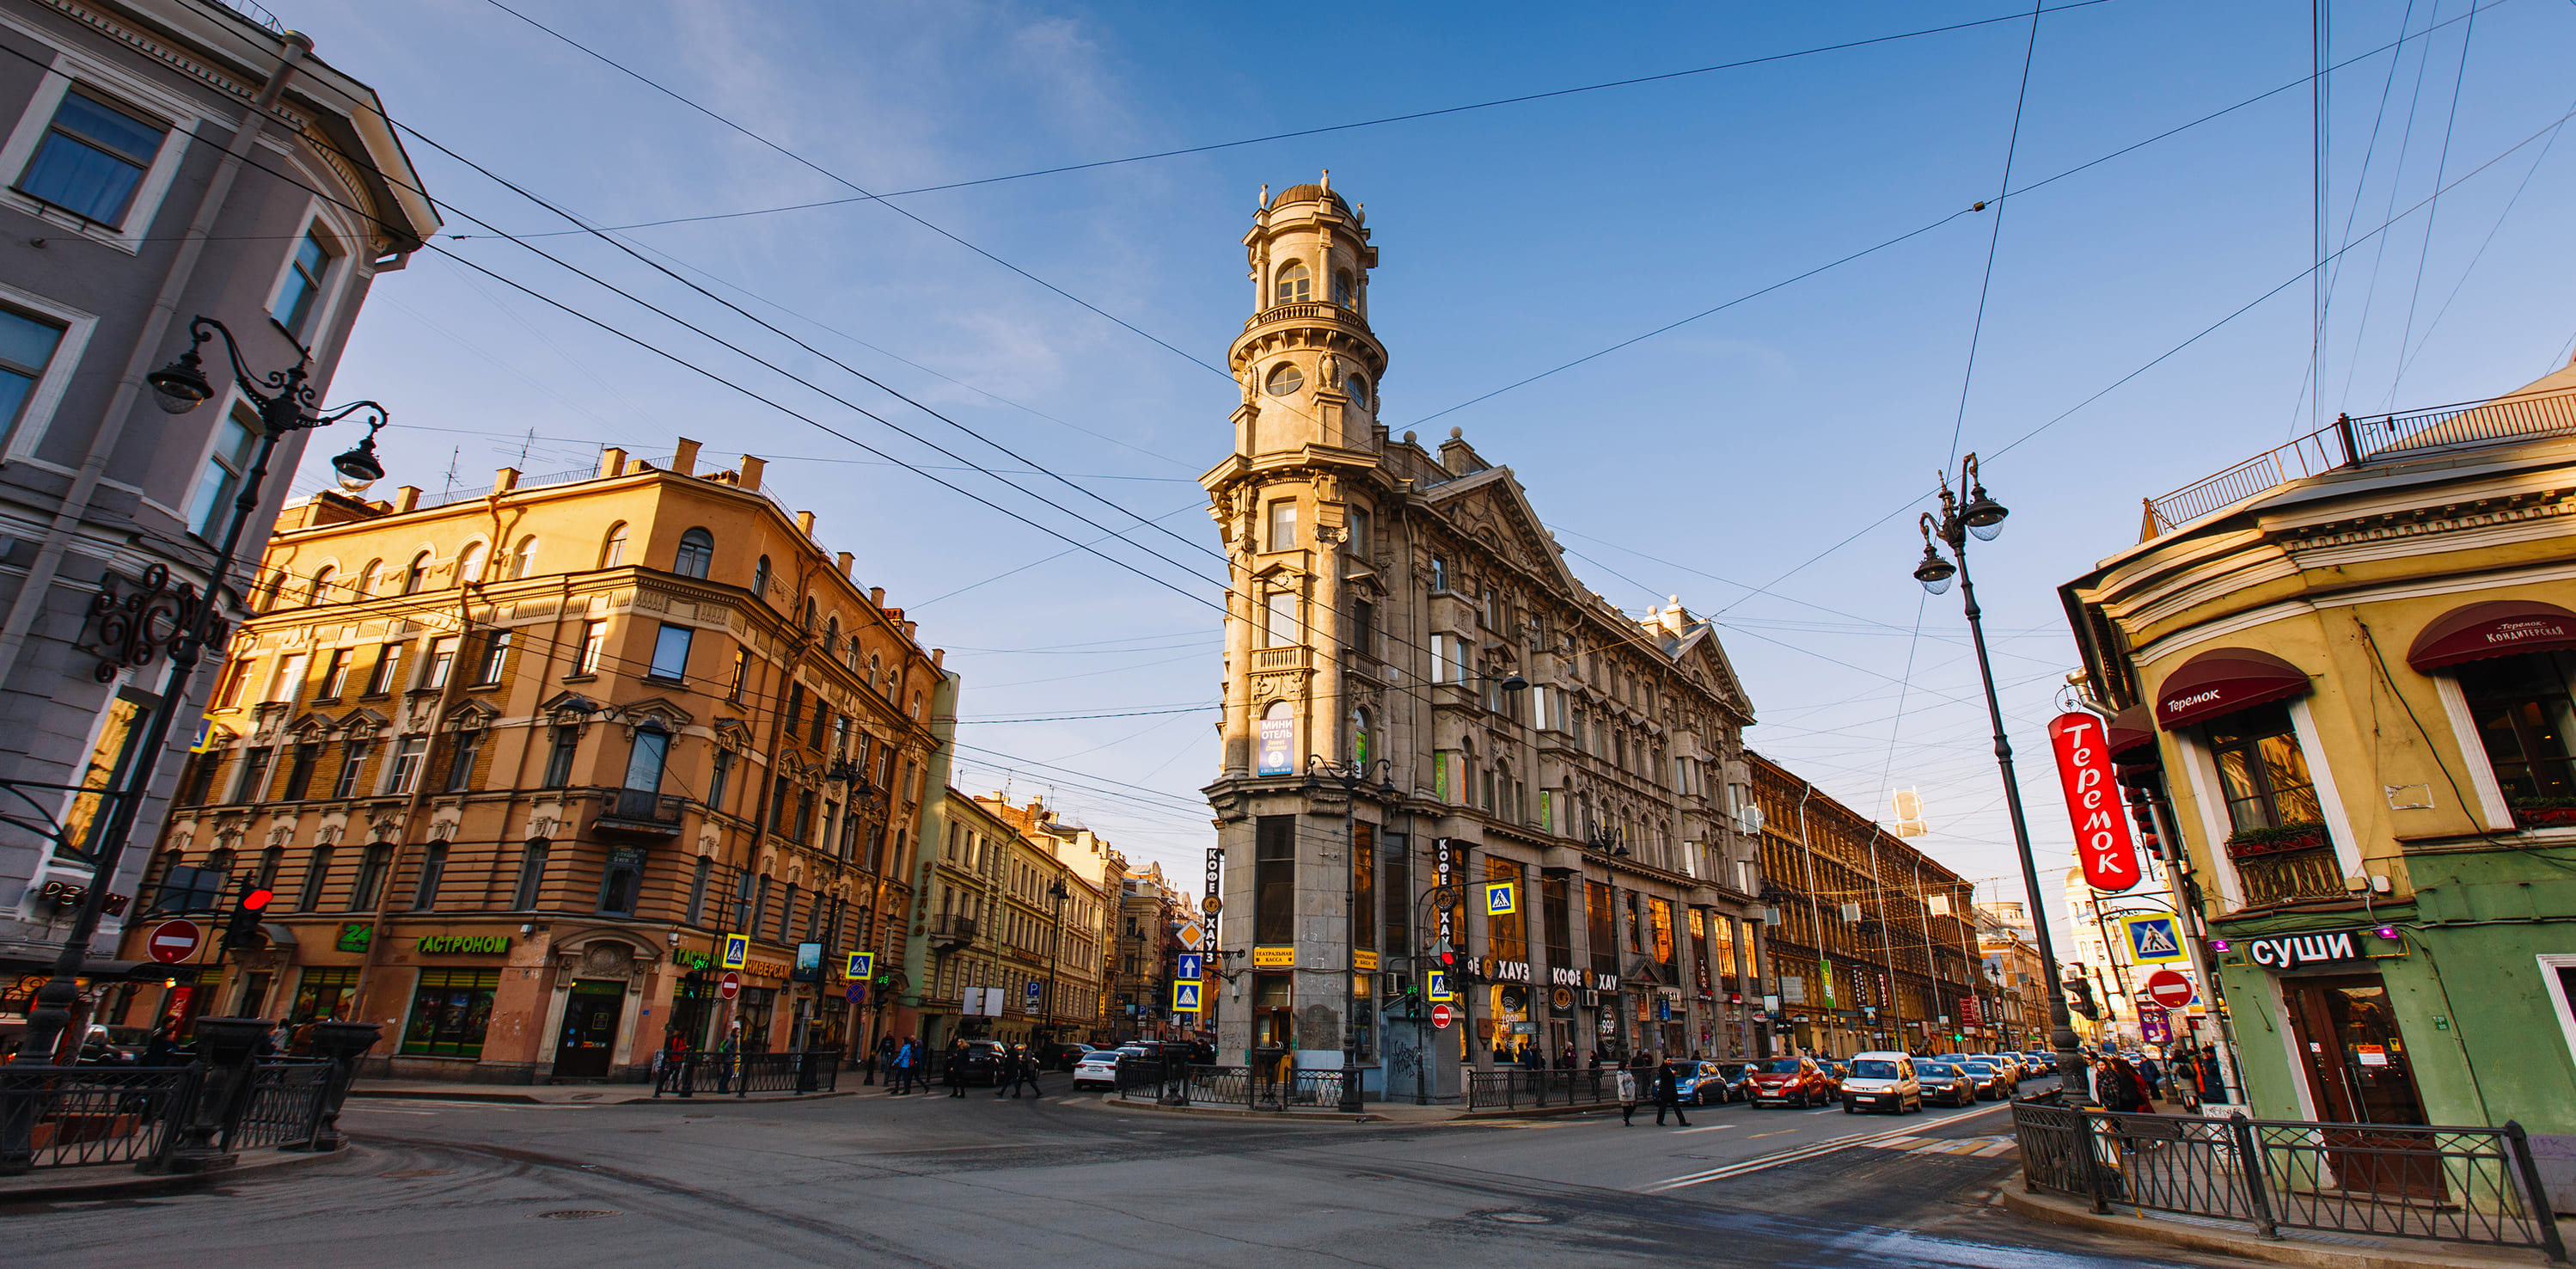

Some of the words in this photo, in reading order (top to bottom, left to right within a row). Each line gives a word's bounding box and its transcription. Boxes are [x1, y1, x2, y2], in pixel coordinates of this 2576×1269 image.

[2167, 689, 2222, 713] Теремок
[1261, 720, 1293, 731] МИНИ
[1261, 729, 1293, 740] ОТЕЛЬ
[2063, 723, 2124, 874] Теремок
[1207, 849, 1218, 893] КОФЕ
[1439, 839, 1450, 886] КОФЕ
[341, 924, 373, 942] 24
[1205, 917, 1216, 963] ХАУЗ
[1440, 911, 1451, 945] ХАУ
[416, 935, 509, 953] ГАСТРОНОМ
[2251, 933, 2355, 969] СУШИ
[744, 959, 791, 980] НИВЕРСАМ
[1498, 959, 1531, 982] ХАУЗ
[1552, 966, 1582, 987] КОФЕ
[1598, 973, 1618, 991] ХАУ
[1823, 969, 1833, 1000] SUBWAY
